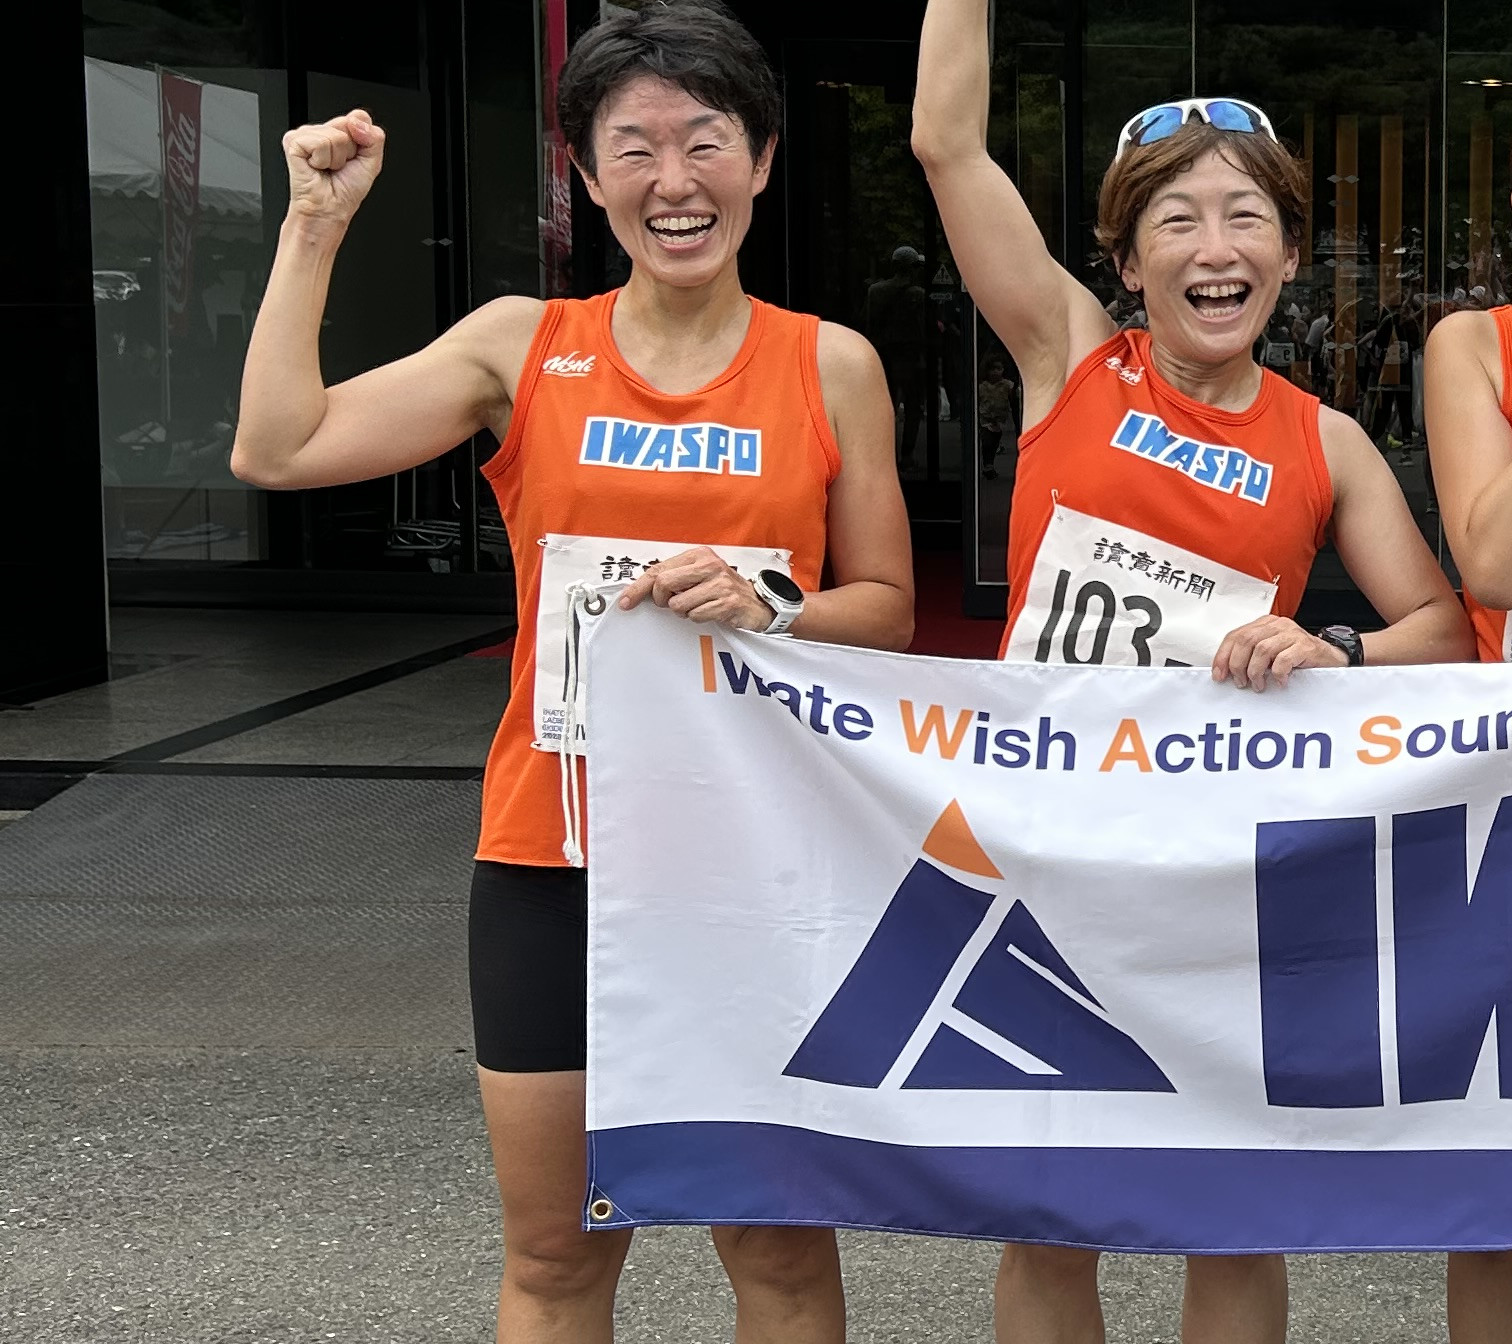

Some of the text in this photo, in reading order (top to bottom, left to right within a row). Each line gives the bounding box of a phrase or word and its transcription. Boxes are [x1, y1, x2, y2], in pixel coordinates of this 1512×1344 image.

[582, 419, 759, 474] IWASPO
[1114, 412, 1271, 503] IWASPO
[699, 635, 874, 741] Iwate
[899, 699, 1077, 772] Wish
[1099, 717, 1333, 774] Action
